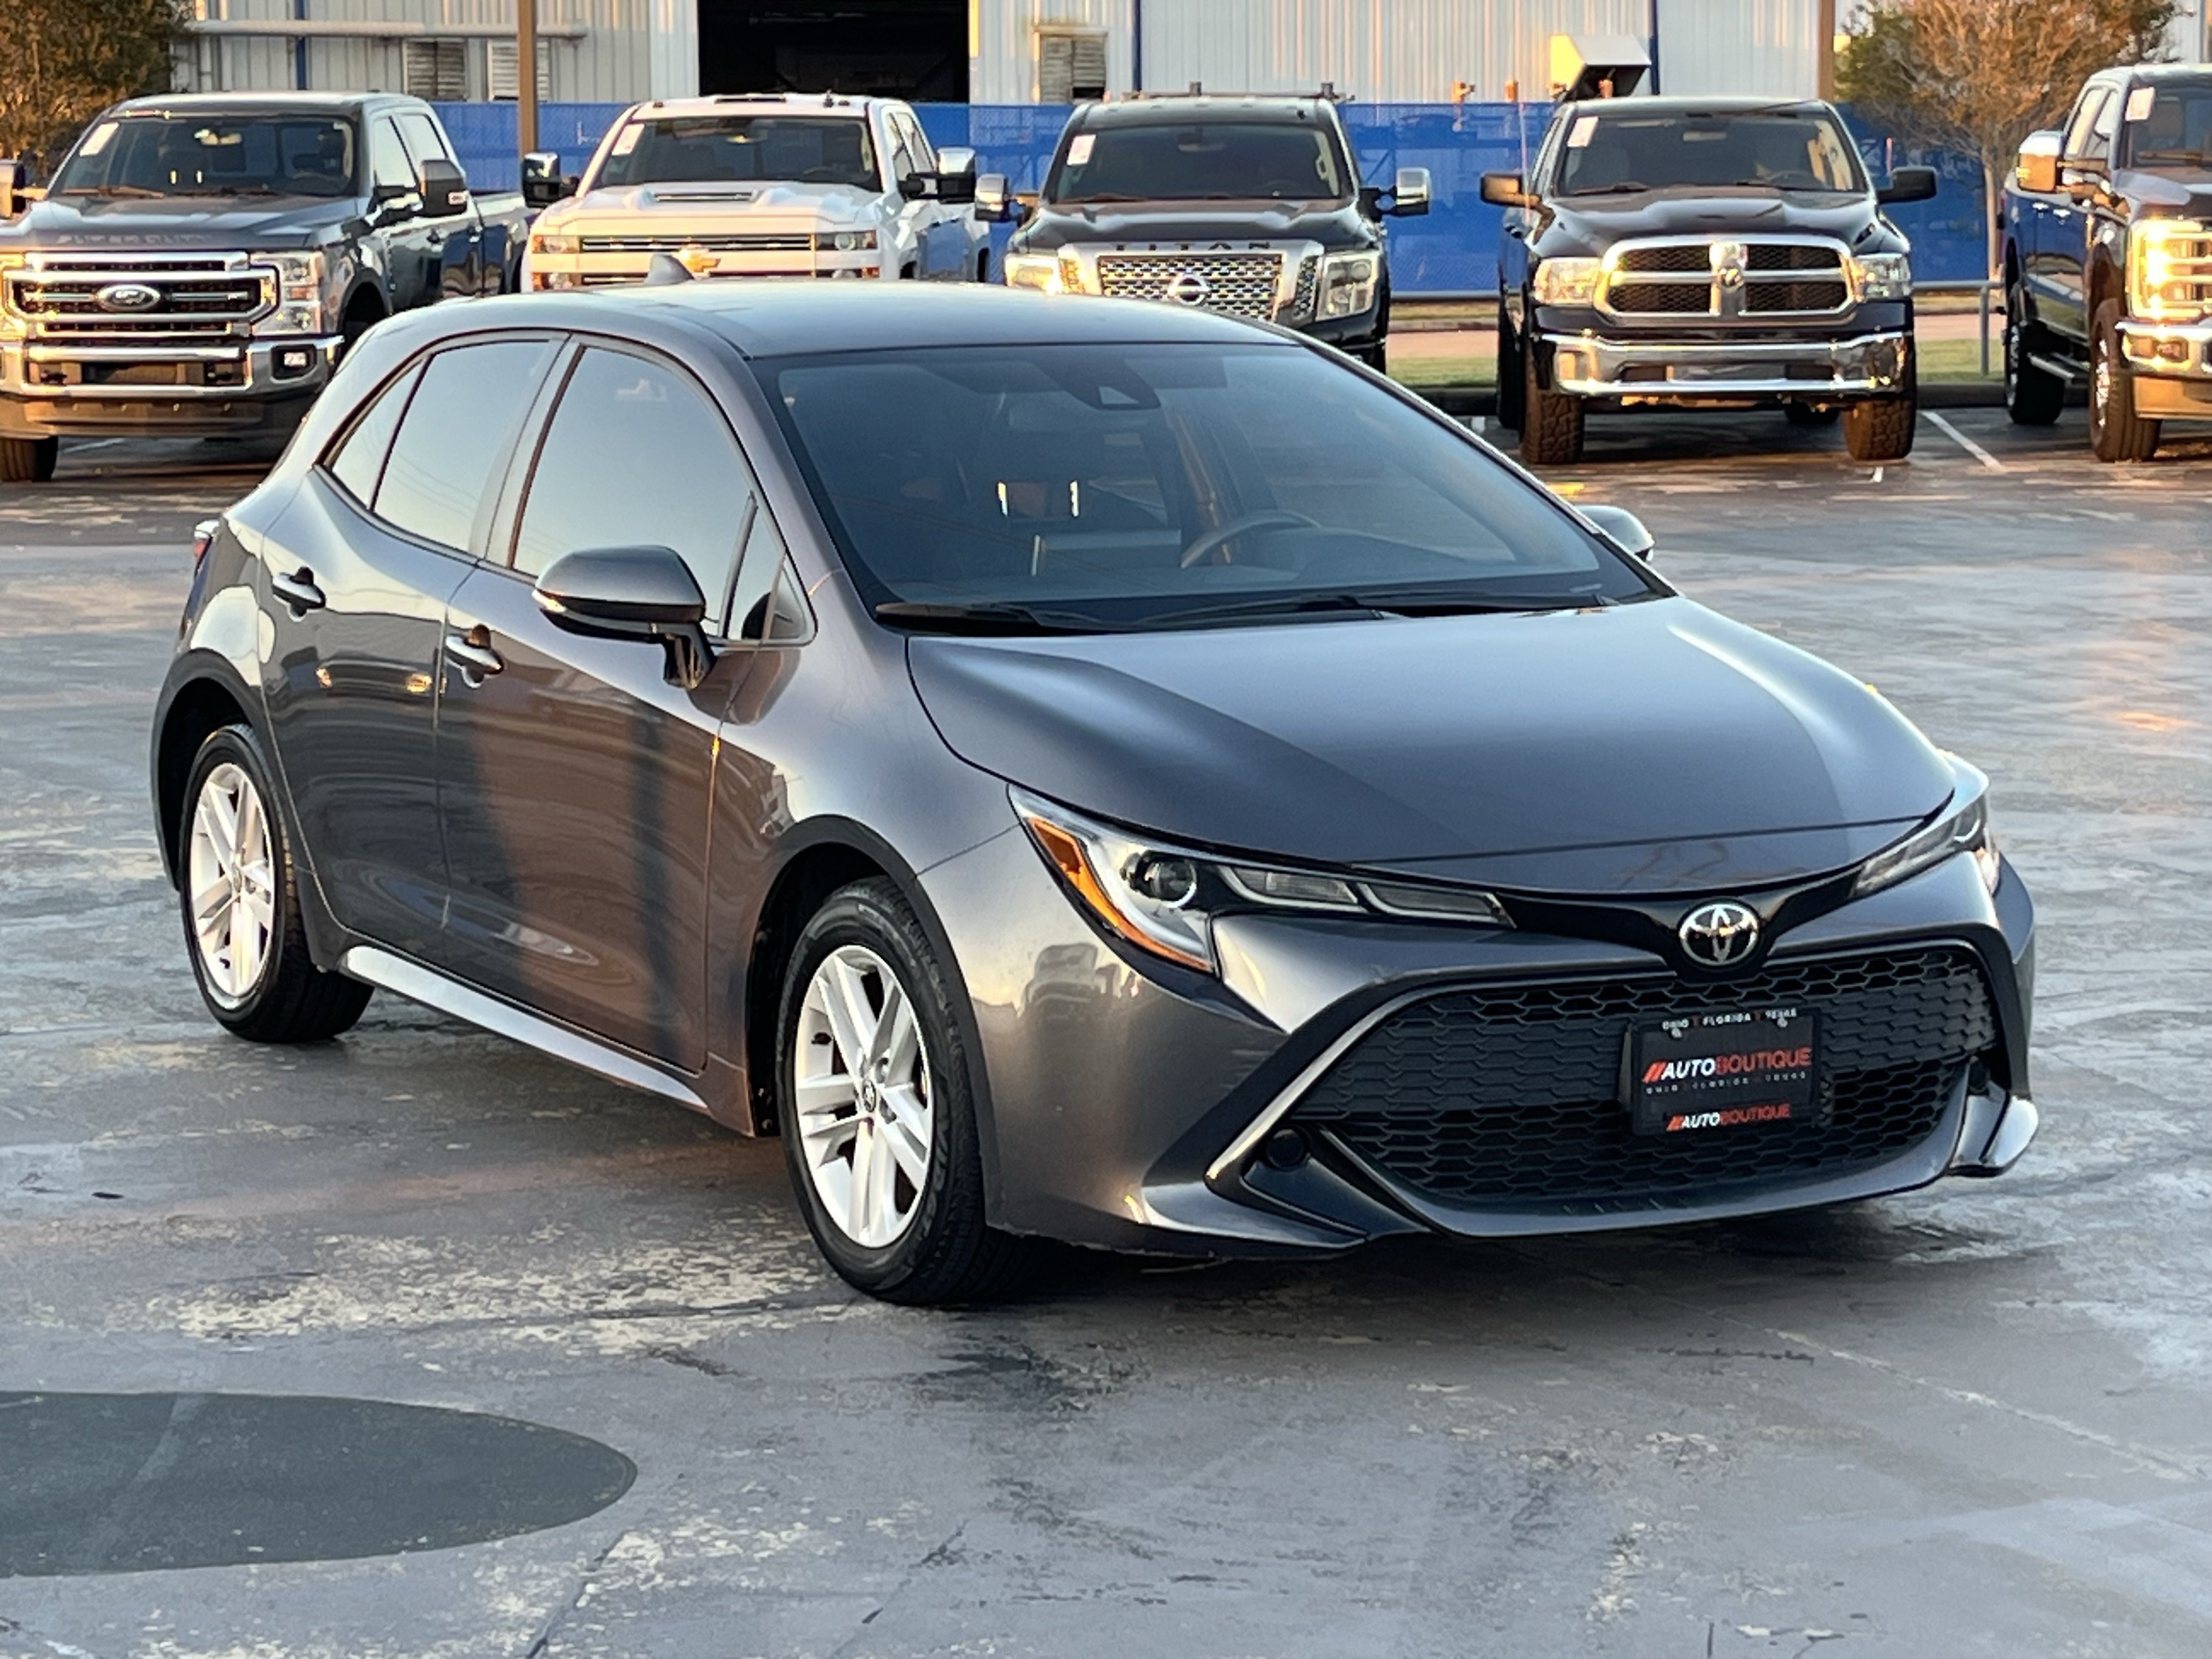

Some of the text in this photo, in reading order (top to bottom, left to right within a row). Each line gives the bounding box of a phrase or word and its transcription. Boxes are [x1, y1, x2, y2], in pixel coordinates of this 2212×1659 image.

[1110, 241, 1271, 251] TITAN
[1661, 1047, 1812, 1080] AUTOBOUTIQUE
[1681, 1103, 1791, 1128] AUTOBOUTIQUE
